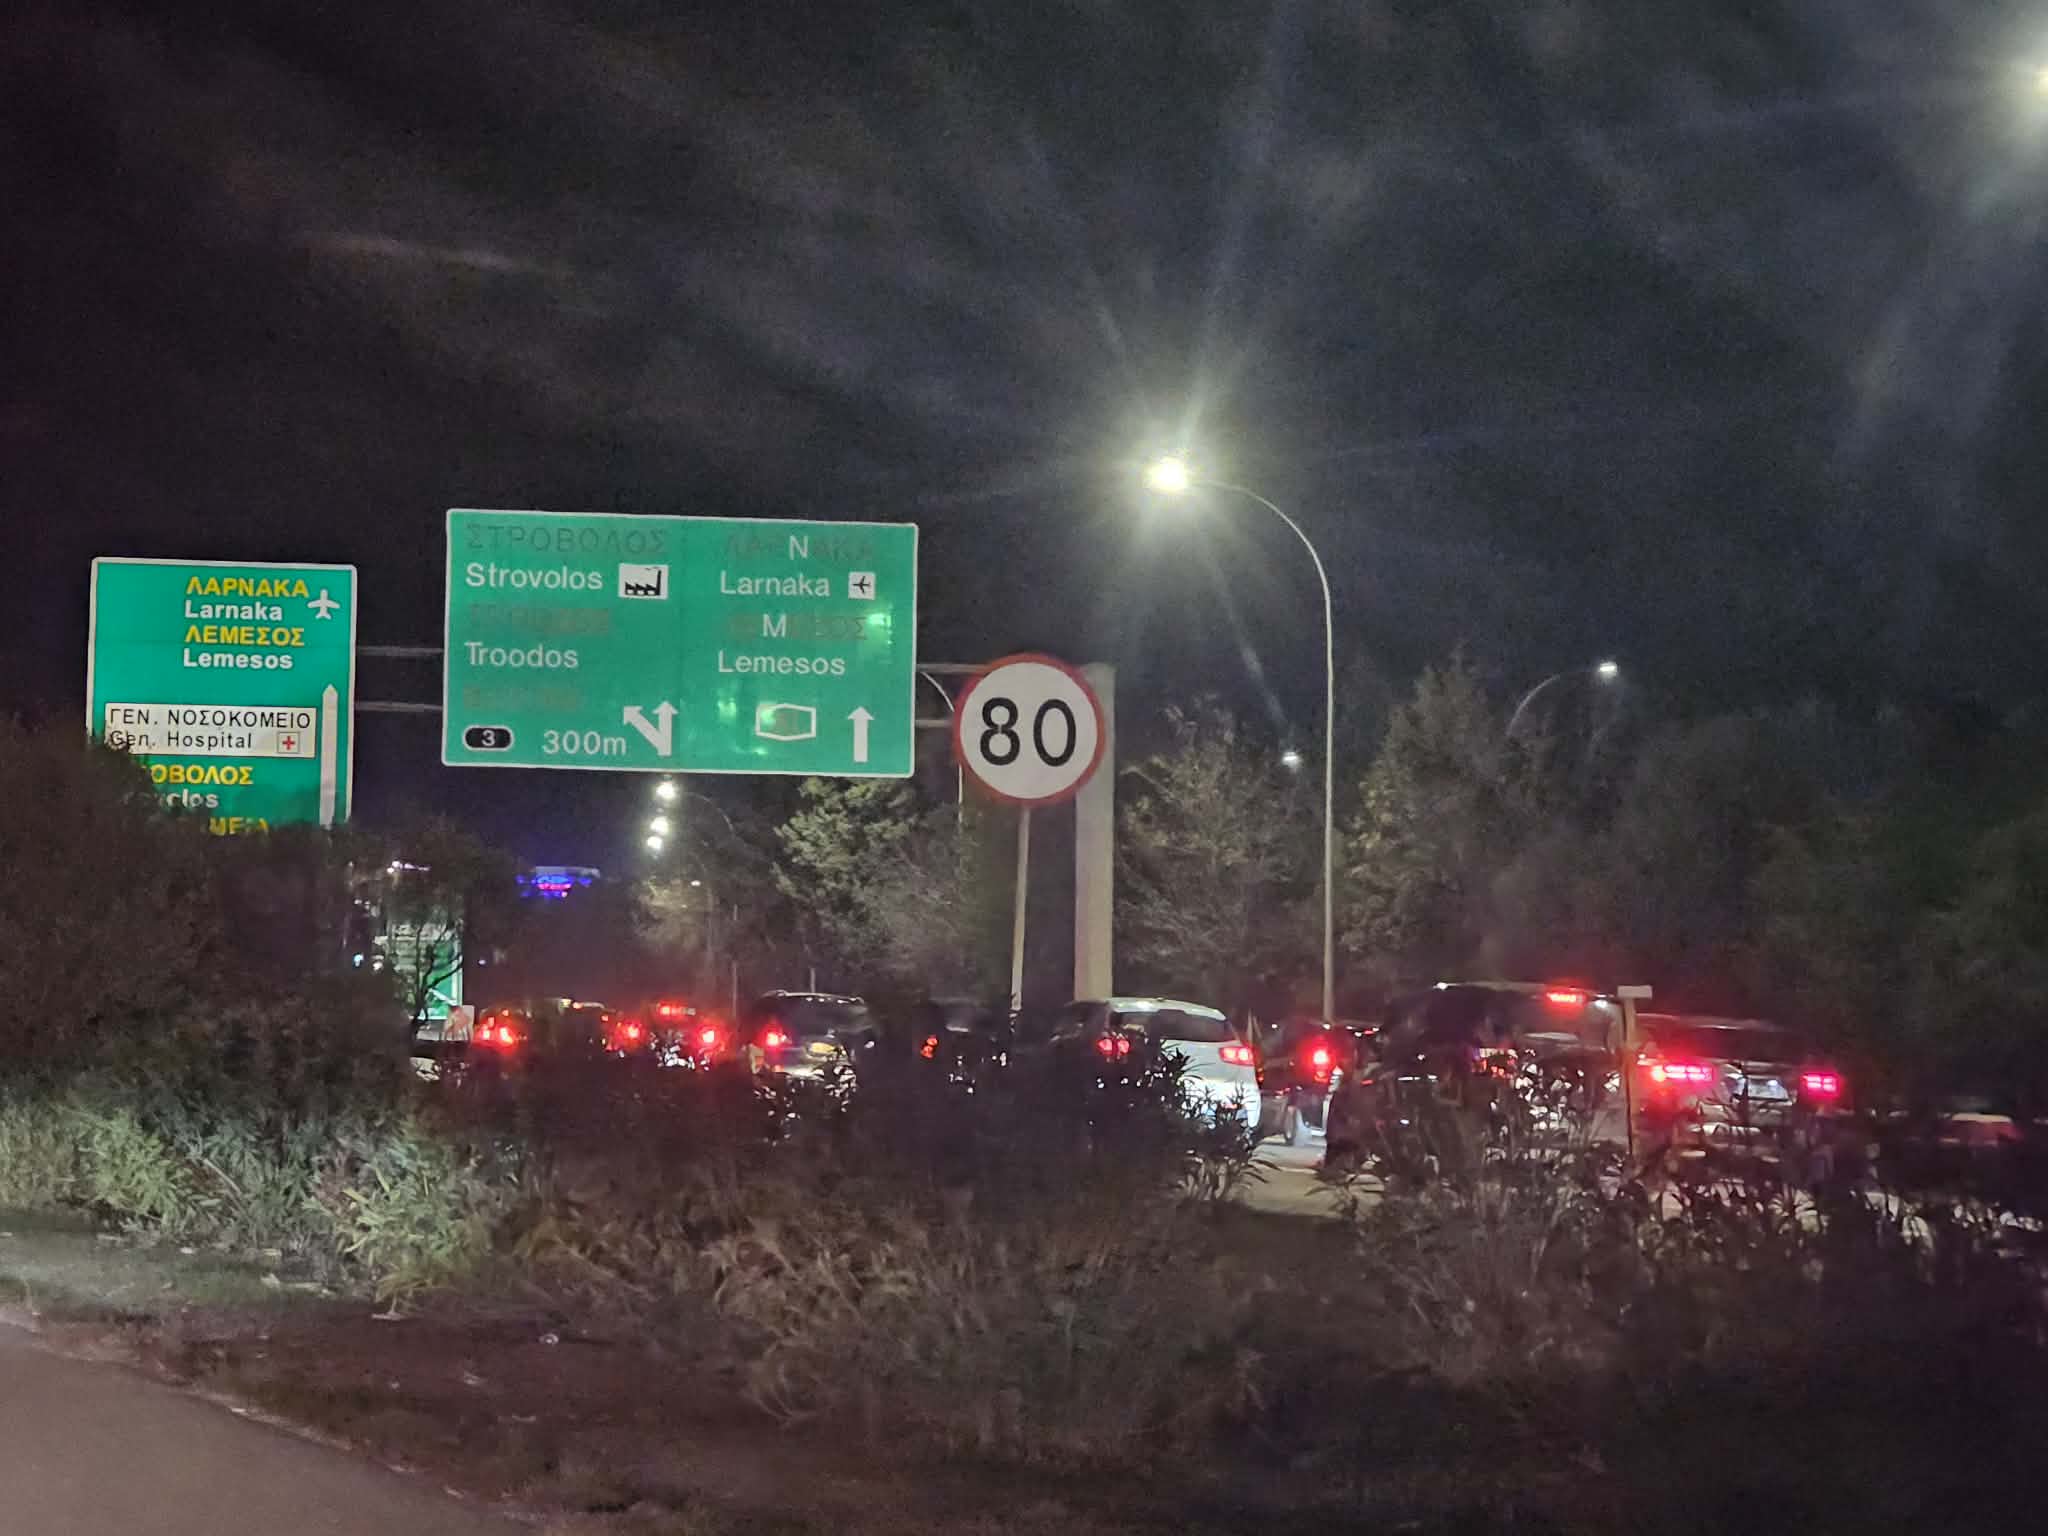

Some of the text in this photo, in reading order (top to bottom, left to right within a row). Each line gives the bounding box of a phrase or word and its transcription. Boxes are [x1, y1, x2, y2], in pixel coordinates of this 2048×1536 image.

[186, 576, 309, 597] ΛΑΡΝΑΚΑ
[465, 562, 603, 590] Strovolos
[720, 570, 830, 597] Larnaka
[184, 599, 282, 621] Larnaka
[185, 625, 304, 647] ΛΕΜΕΣΟΣ
[183, 648, 293, 669] Lemesos
[464, 641, 579, 669] Troodos
[718, 650, 845, 676] Lemesos
[110, 708, 311, 728] ΓΕΝ. ΝΟΣΟΚΟΜΕΙΟ
[111, 730, 252, 751] Gen. Hospital
[481, 729, 496, 747] 3
[979, 697, 1077, 767] 80
[542, 730, 627, 757] 300m
